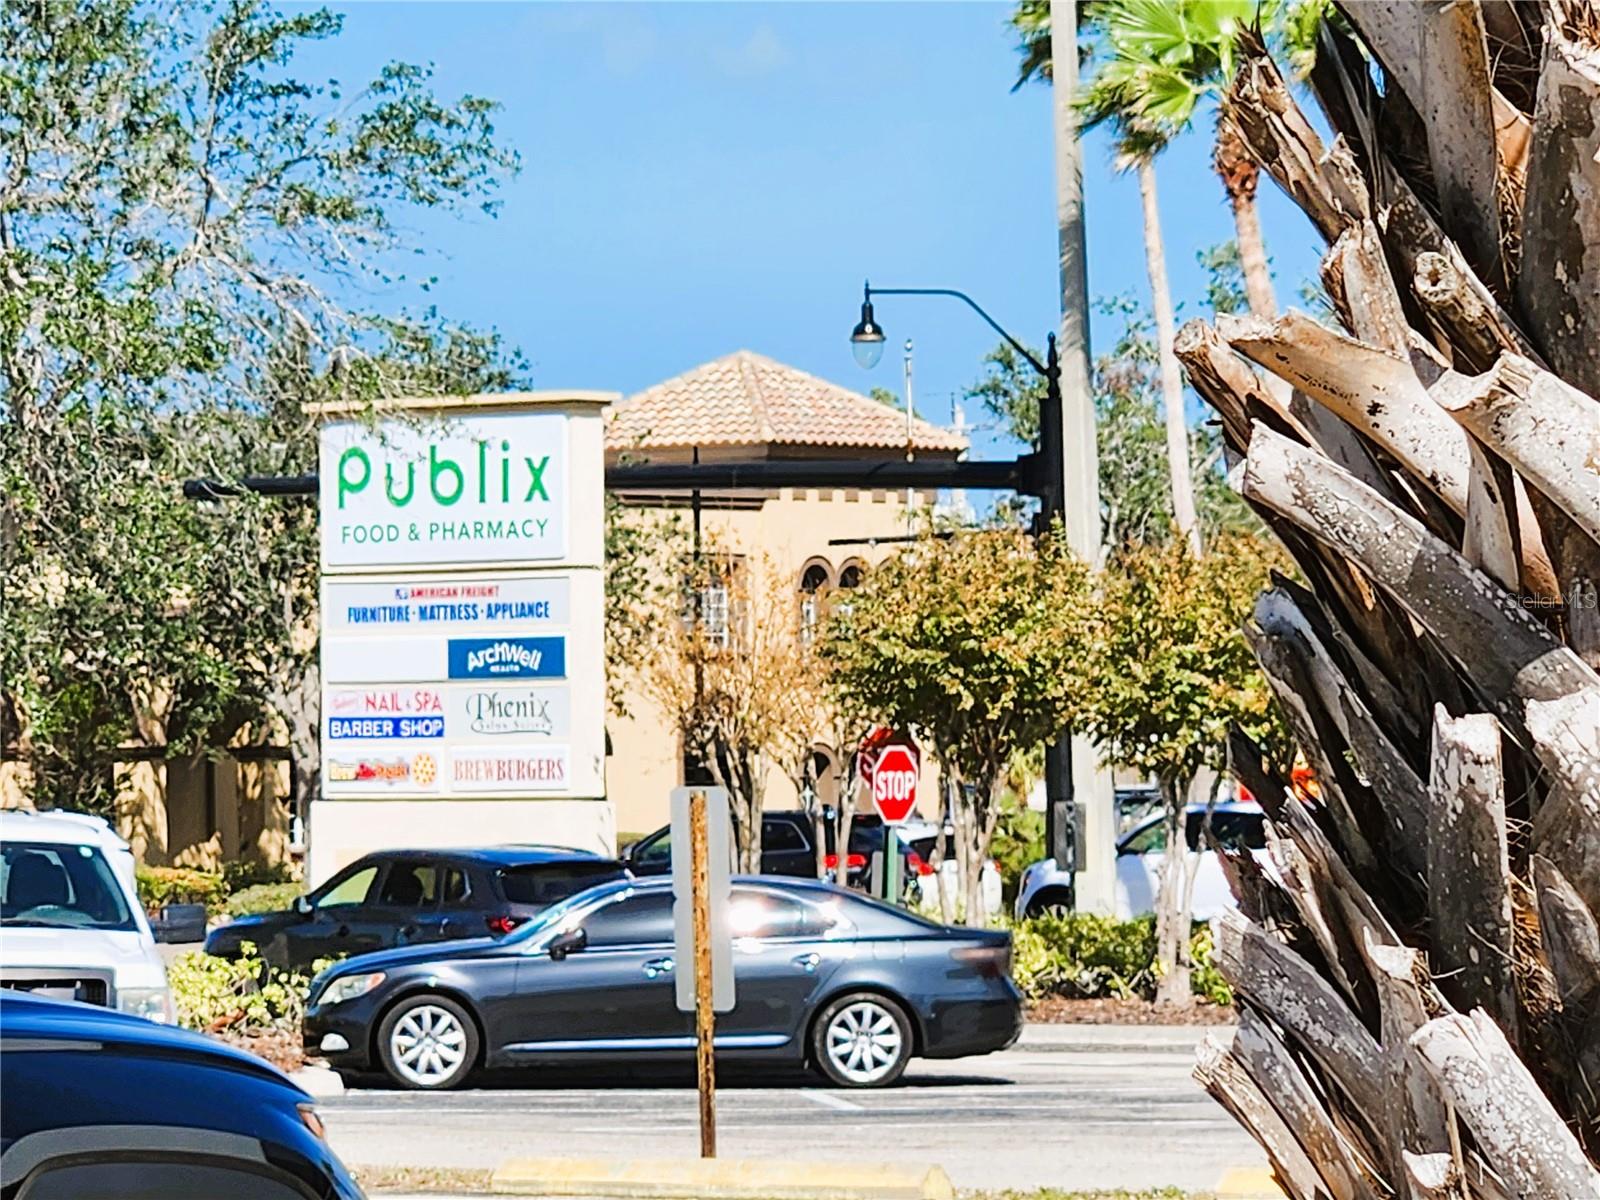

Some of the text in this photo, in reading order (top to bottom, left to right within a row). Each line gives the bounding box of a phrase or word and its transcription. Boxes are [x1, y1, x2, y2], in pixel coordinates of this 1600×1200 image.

[338, 439, 550, 510] Publix
[341, 518, 549, 544] FOOD & PHARMACY
[347, 601, 550, 623] FURNITURE MATTRESS APPLIANCE
[365, 691, 402, 713] NAIL
[415, 690, 443, 712] SPA
[466, 690, 551, 723] Phenix
[330, 719, 443, 738] BARBER SHOP
[876, 769, 915, 801] STOP
